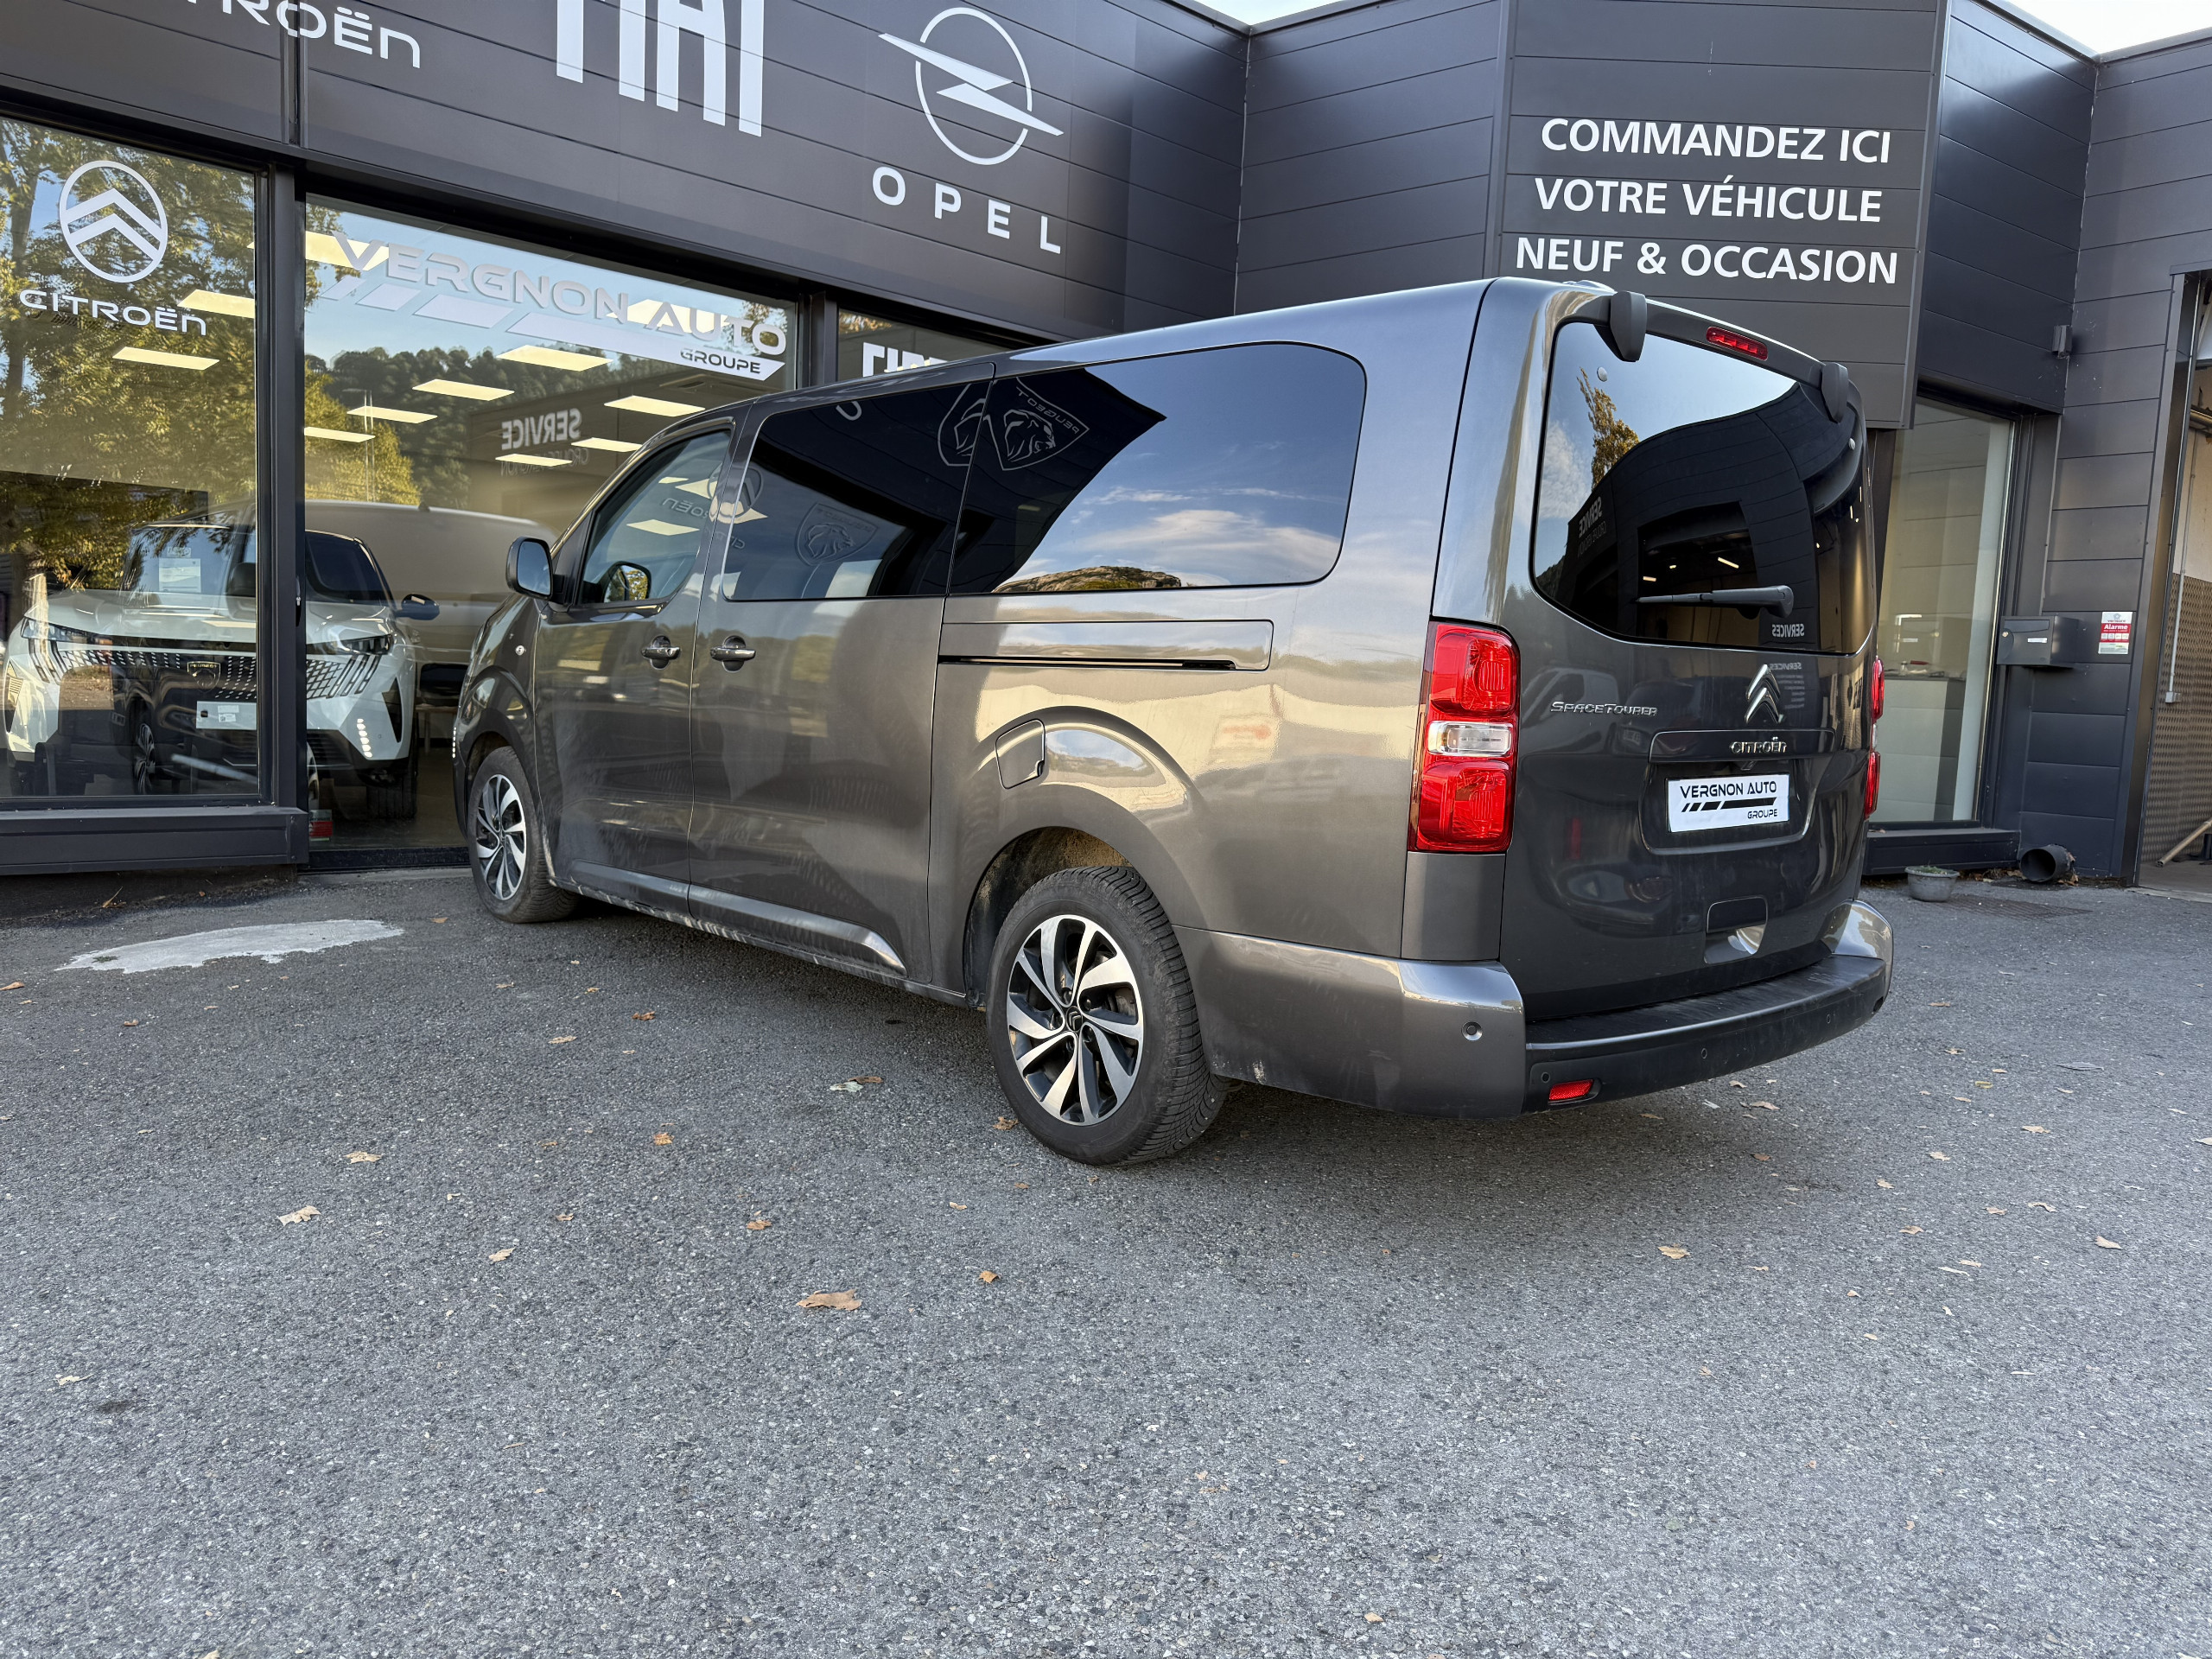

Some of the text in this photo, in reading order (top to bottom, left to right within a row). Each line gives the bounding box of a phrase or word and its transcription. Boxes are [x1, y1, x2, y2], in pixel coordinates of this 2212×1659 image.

[1541, 118, 1891, 164] COMMANDEZ ICI
[872, 166, 1061, 254] OPEL
[1535, 175, 1883, 223] VOTRE VÉHICULE
[1515, 237, 1898, 285] NEUF & OCCASION
[330, 230, 787, 355] VERGNON AUTO
[679, 347, 761, 375] GROUPE
[1680, 780, 1777, 799] VERGNON AUTO
[1747, 809, 1778, 819] GROUPE
